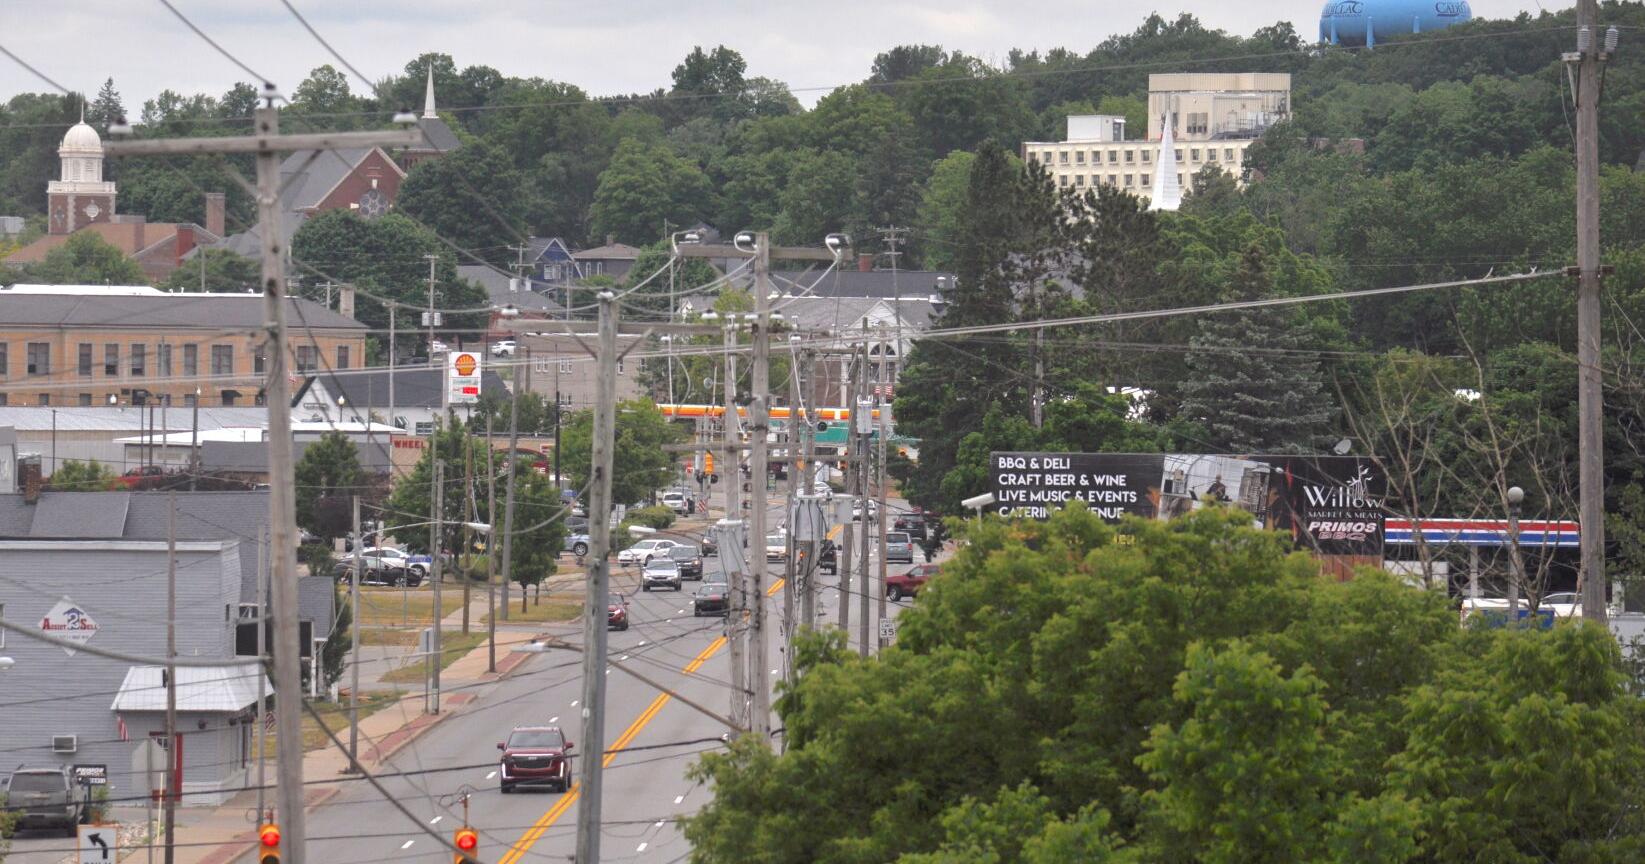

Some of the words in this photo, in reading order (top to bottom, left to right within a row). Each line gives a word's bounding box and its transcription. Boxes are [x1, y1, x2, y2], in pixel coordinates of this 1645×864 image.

[998, 457, 1026, 469] BBQ
[1030, 458, 1039, 469] &
[1043, 458, 1070, 469] DELI
[998, 473, 1041, 485] CRAFT
[1045, 474, 1075, 486] BEER
[1080, 474, 1089, 486] &
[1093, 474, 1126, 486] WINE
[999, 490, 1026, 502] LIVE
[1030, 490, 1070, 502] MUSIC
[1075, 490, 1084, 502] &
[1088, 490, 1137, 502] EVENTS
[1303, 485, 1382, 508] Willow
[998, 506, 1062, 518] CATERIN
[1086, 506, 1124, 519] ENUE
[1308, 521, 1377, 533] PRIMOS
[1318, 531, 1367, 542] BBQ
[67, 611, 80, 630] 2
[881, 628, 895, 636] 35
